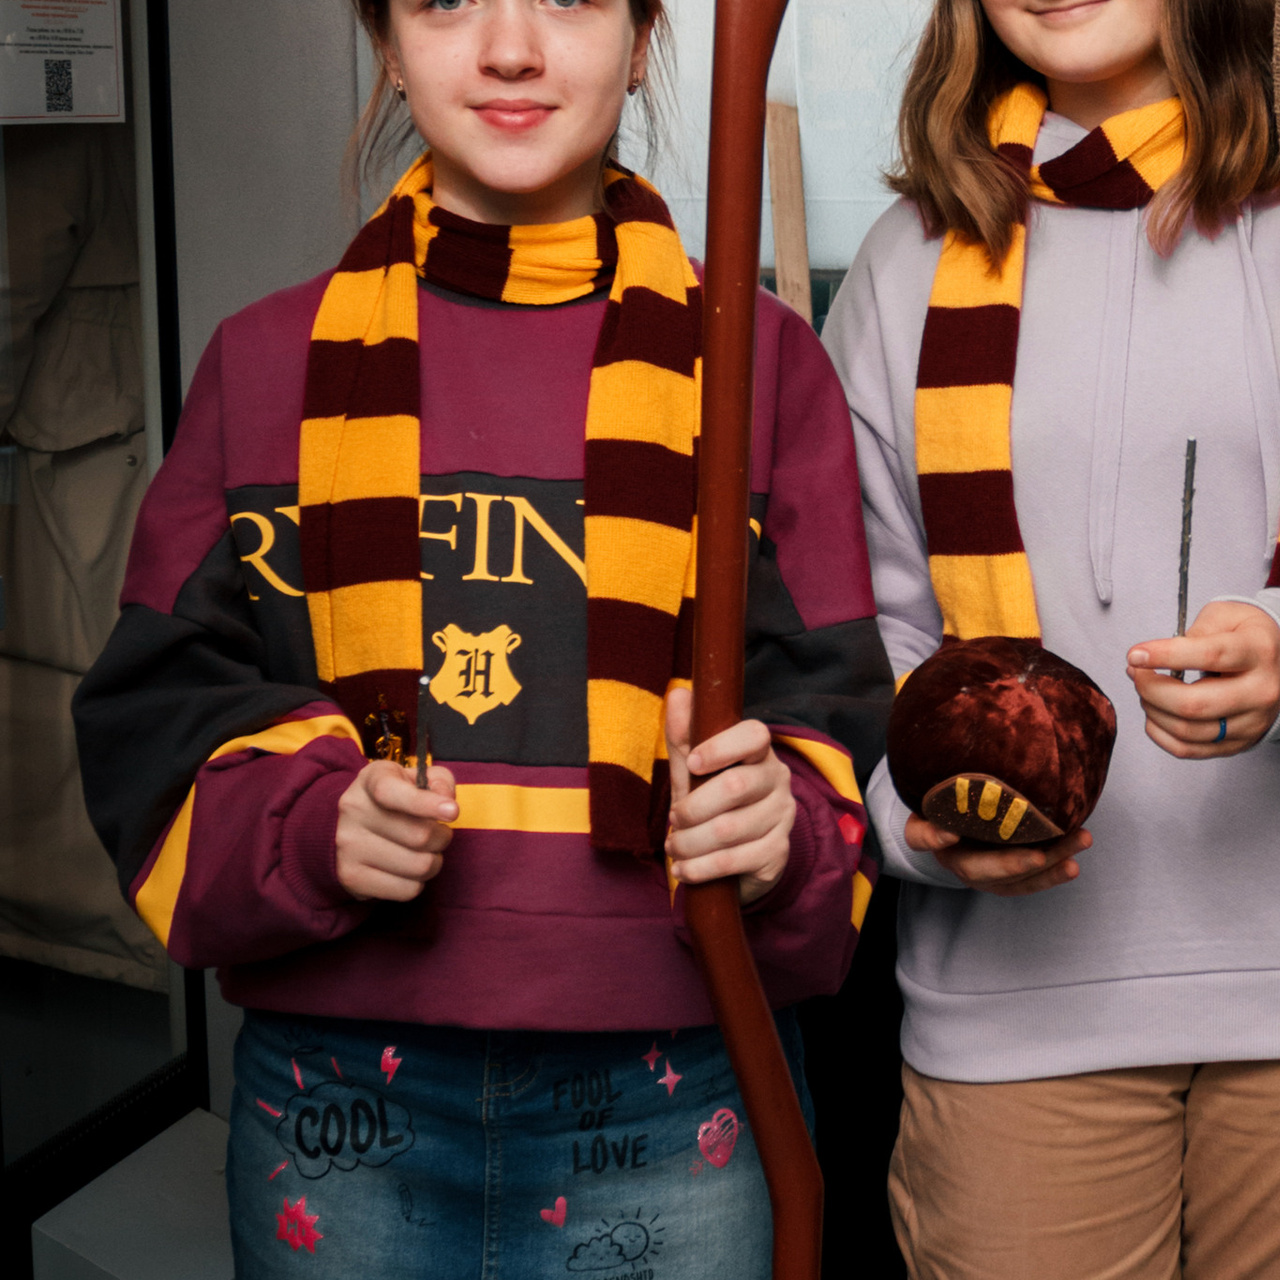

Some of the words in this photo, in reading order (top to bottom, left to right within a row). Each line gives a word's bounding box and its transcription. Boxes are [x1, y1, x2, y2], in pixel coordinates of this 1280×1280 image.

[455, 648, 495, 698] H
[553, 1068, 623, 1111] FOOL
[295, 1096, 404, 1159] COOL
[579, 1106, 615, 1131] OF
[573, 1134, 649, 1175] LOVE
